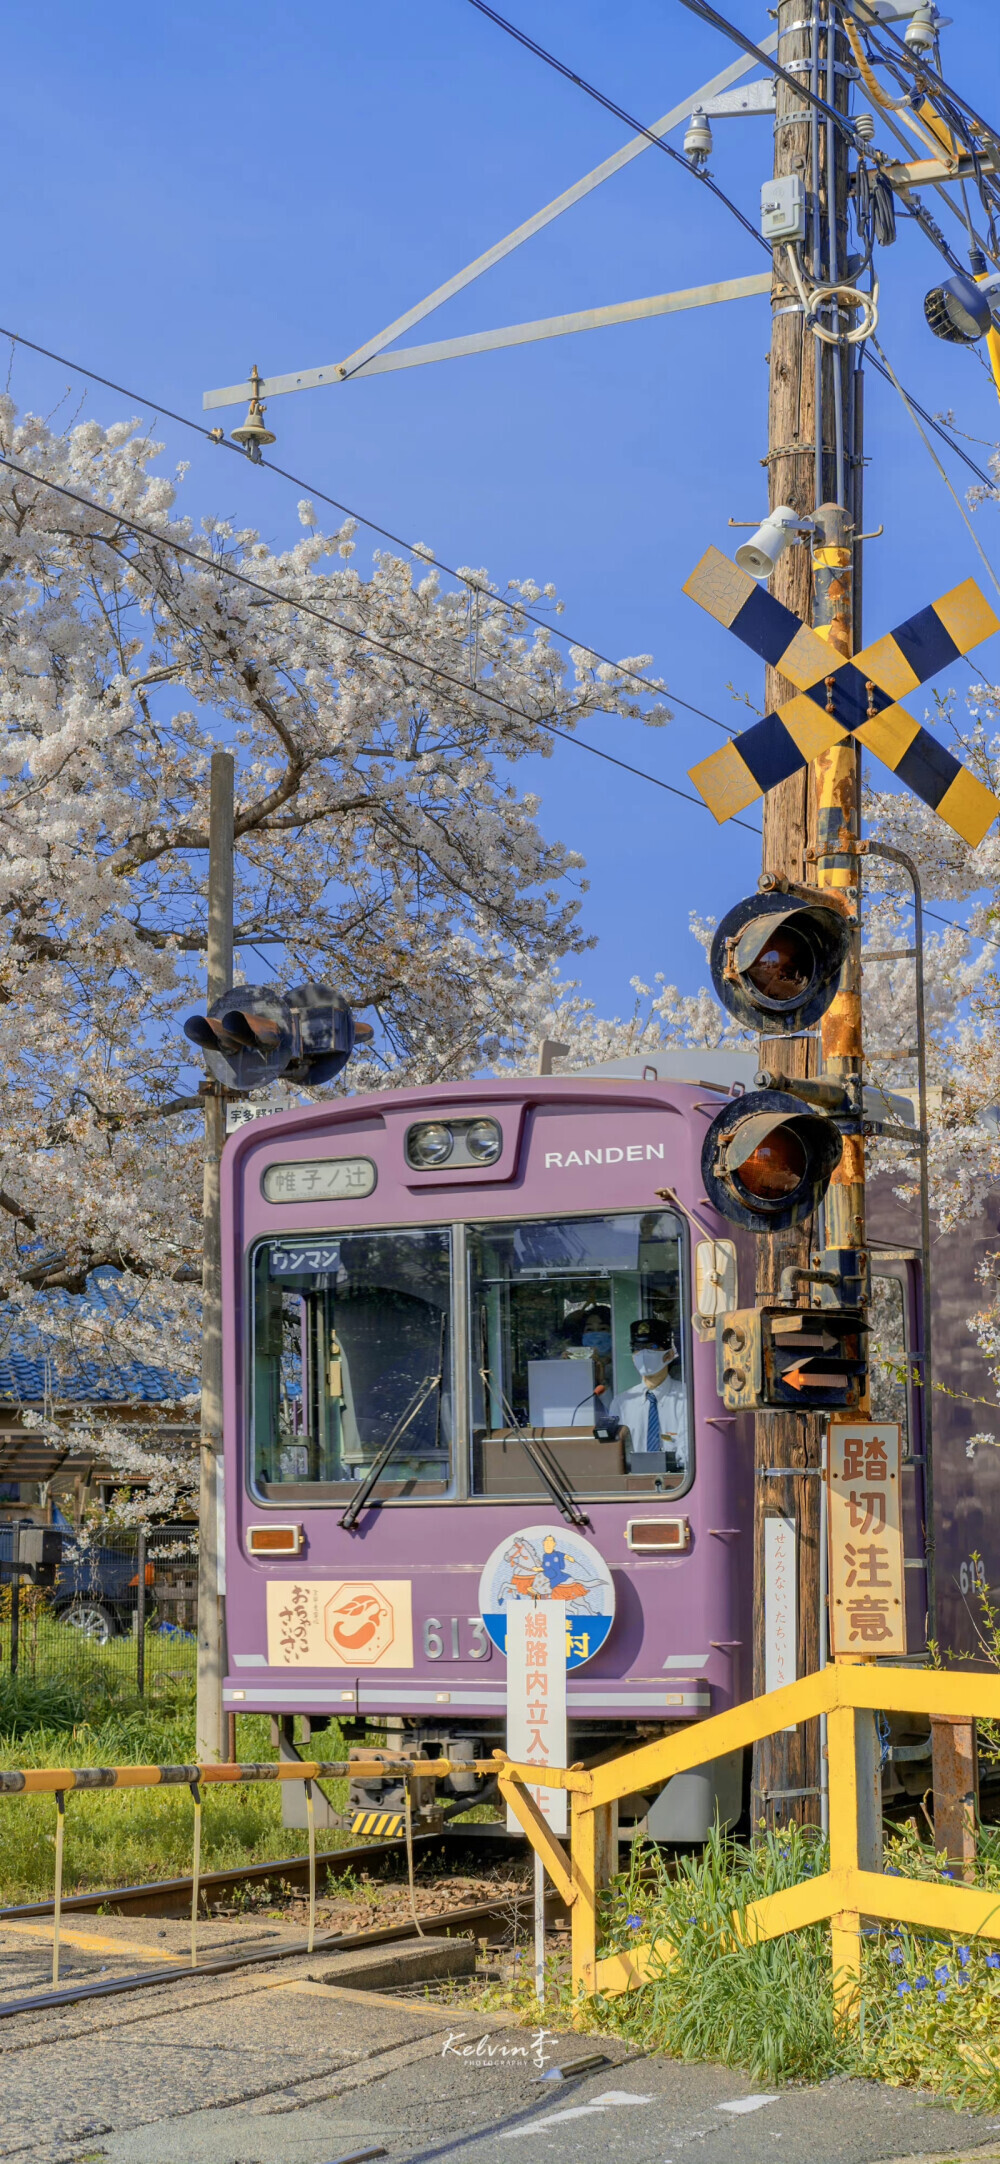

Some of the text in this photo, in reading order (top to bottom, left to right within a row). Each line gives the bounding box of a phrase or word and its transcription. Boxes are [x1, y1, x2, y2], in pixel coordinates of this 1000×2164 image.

[545, 1143, 664, 1169] RANDEN
[275, 1166, 367, 1193] 帷子ノ辻
[273, 1250, 338, 1270] ワンマン
[841, 1436, 894, 1642] 踏切注意
[959, 1560, 987, 1595] 613
[424, 1617, 489, 1659] 613
